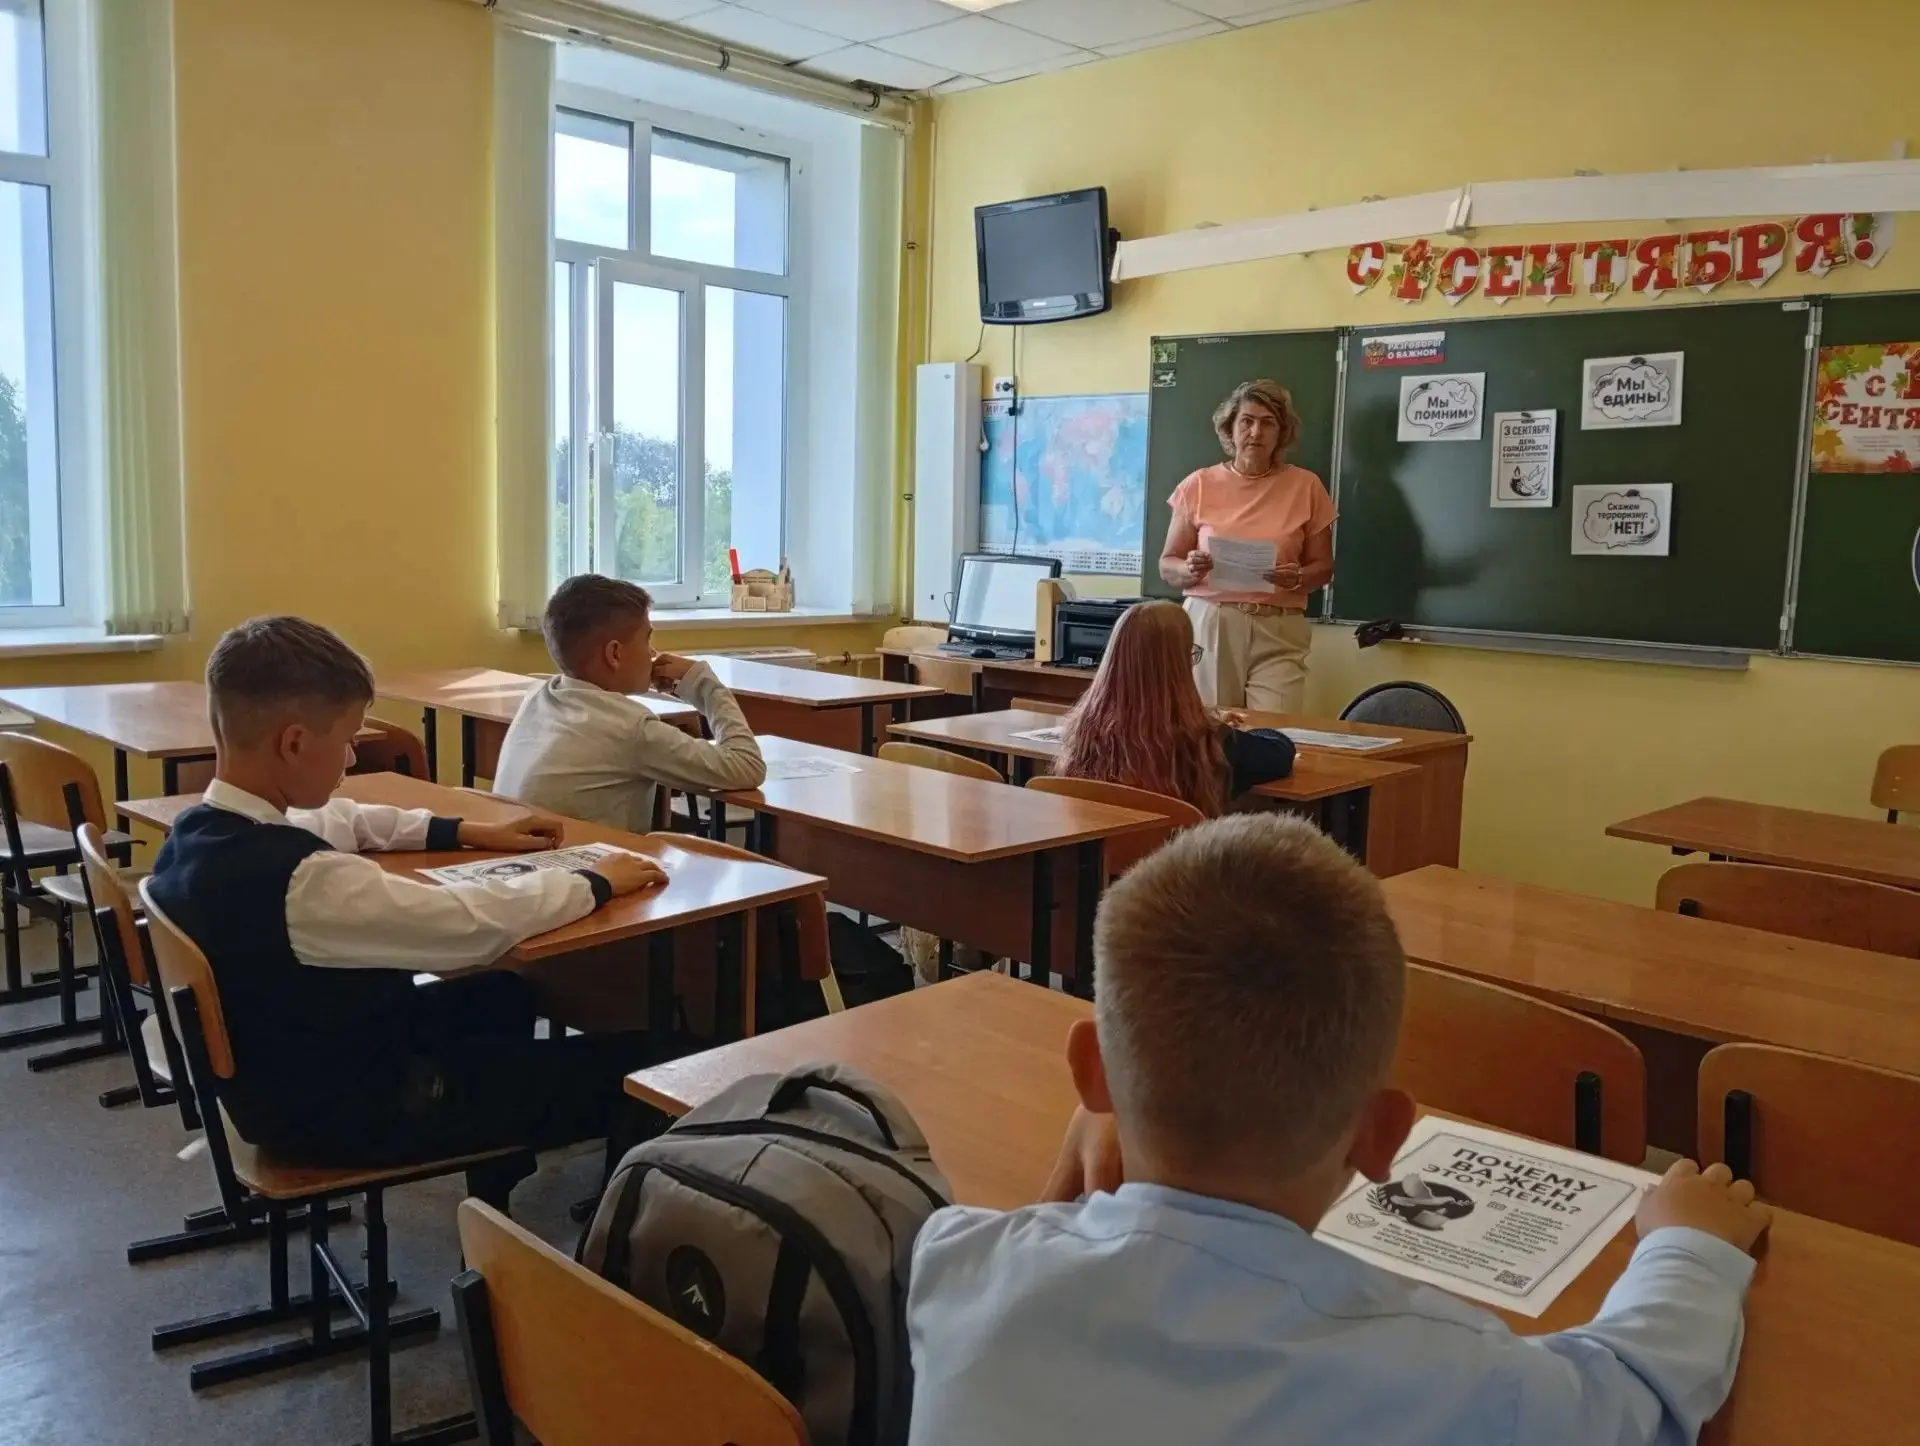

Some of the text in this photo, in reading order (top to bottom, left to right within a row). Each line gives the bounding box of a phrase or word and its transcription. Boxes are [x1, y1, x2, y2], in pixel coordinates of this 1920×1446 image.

[1347, 241, 1385, 287] С
[1387, 339, 1442, 350] РАЗГОВОРЫ
[1387, 349, 1437, 360] О ВАЖНОМ
[1617, 377, 1645, 392] Мы
[1865, 375, 1886, 397] С
[1427, 396, 1449, 409] Мы
[1603, 391, 1661, 408] едины
[1414, 409, 1468, 421] помним
[1504, 424, 1550, 436] 3 СЕНТЯБРЯ
[1608, 502, 1640, 511] Скажем
[1597, 511, 1649, 520] терроризму:
[1614, 521, 1644, 535] НЕТ!
[1453, 1148, 1598, 1192] ПОЧЕМУ
[1451, 1160, 1577, 1202] ВАЖЕН
[1422, 1164, 1582, 1216] ЭТОТ ДЕНЬ?
